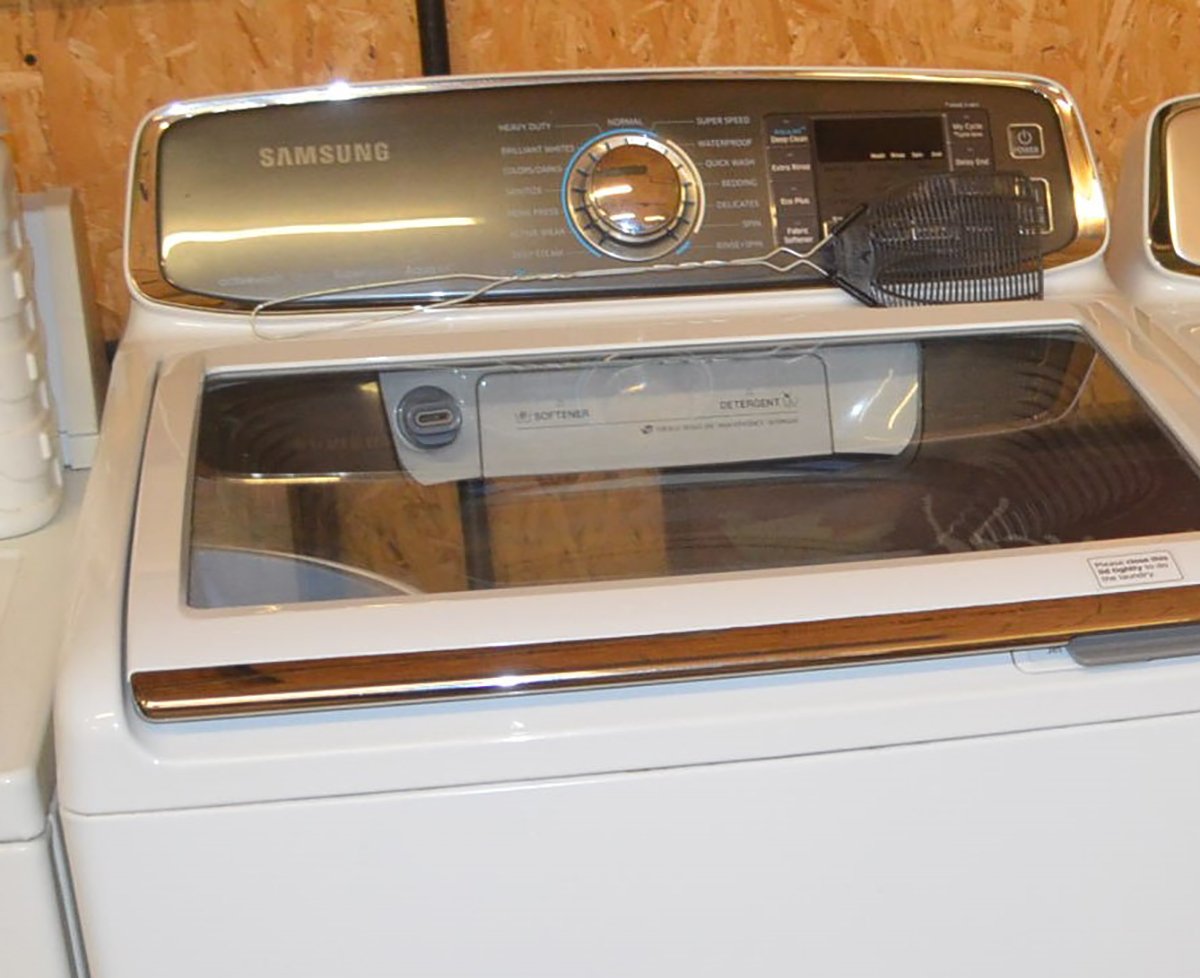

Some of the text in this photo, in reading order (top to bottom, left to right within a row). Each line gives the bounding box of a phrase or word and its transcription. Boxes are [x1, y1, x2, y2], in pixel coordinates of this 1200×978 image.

[607, 117, 645, 127] NORMAL
[695, 115, 751, 126] SUPER SPEED
[964, 121, 984, 130] Cycle
[497, 121, 551, 132] HEAVY DUTY
[697, 137, 753, 147] WATERPROOF
[259, 141, 390, 168] SAMSUNG
[1015, 145, 1040, 155] POWER
[704, 158, 756, 168] QUICK WASH
[721, 178, 758, 187] BEDDING
[715, 199, 760, 209] DELICATES
[719, 396, 780, 410] DETERGENT
[534, 408, 590, 422] SOFTENER
